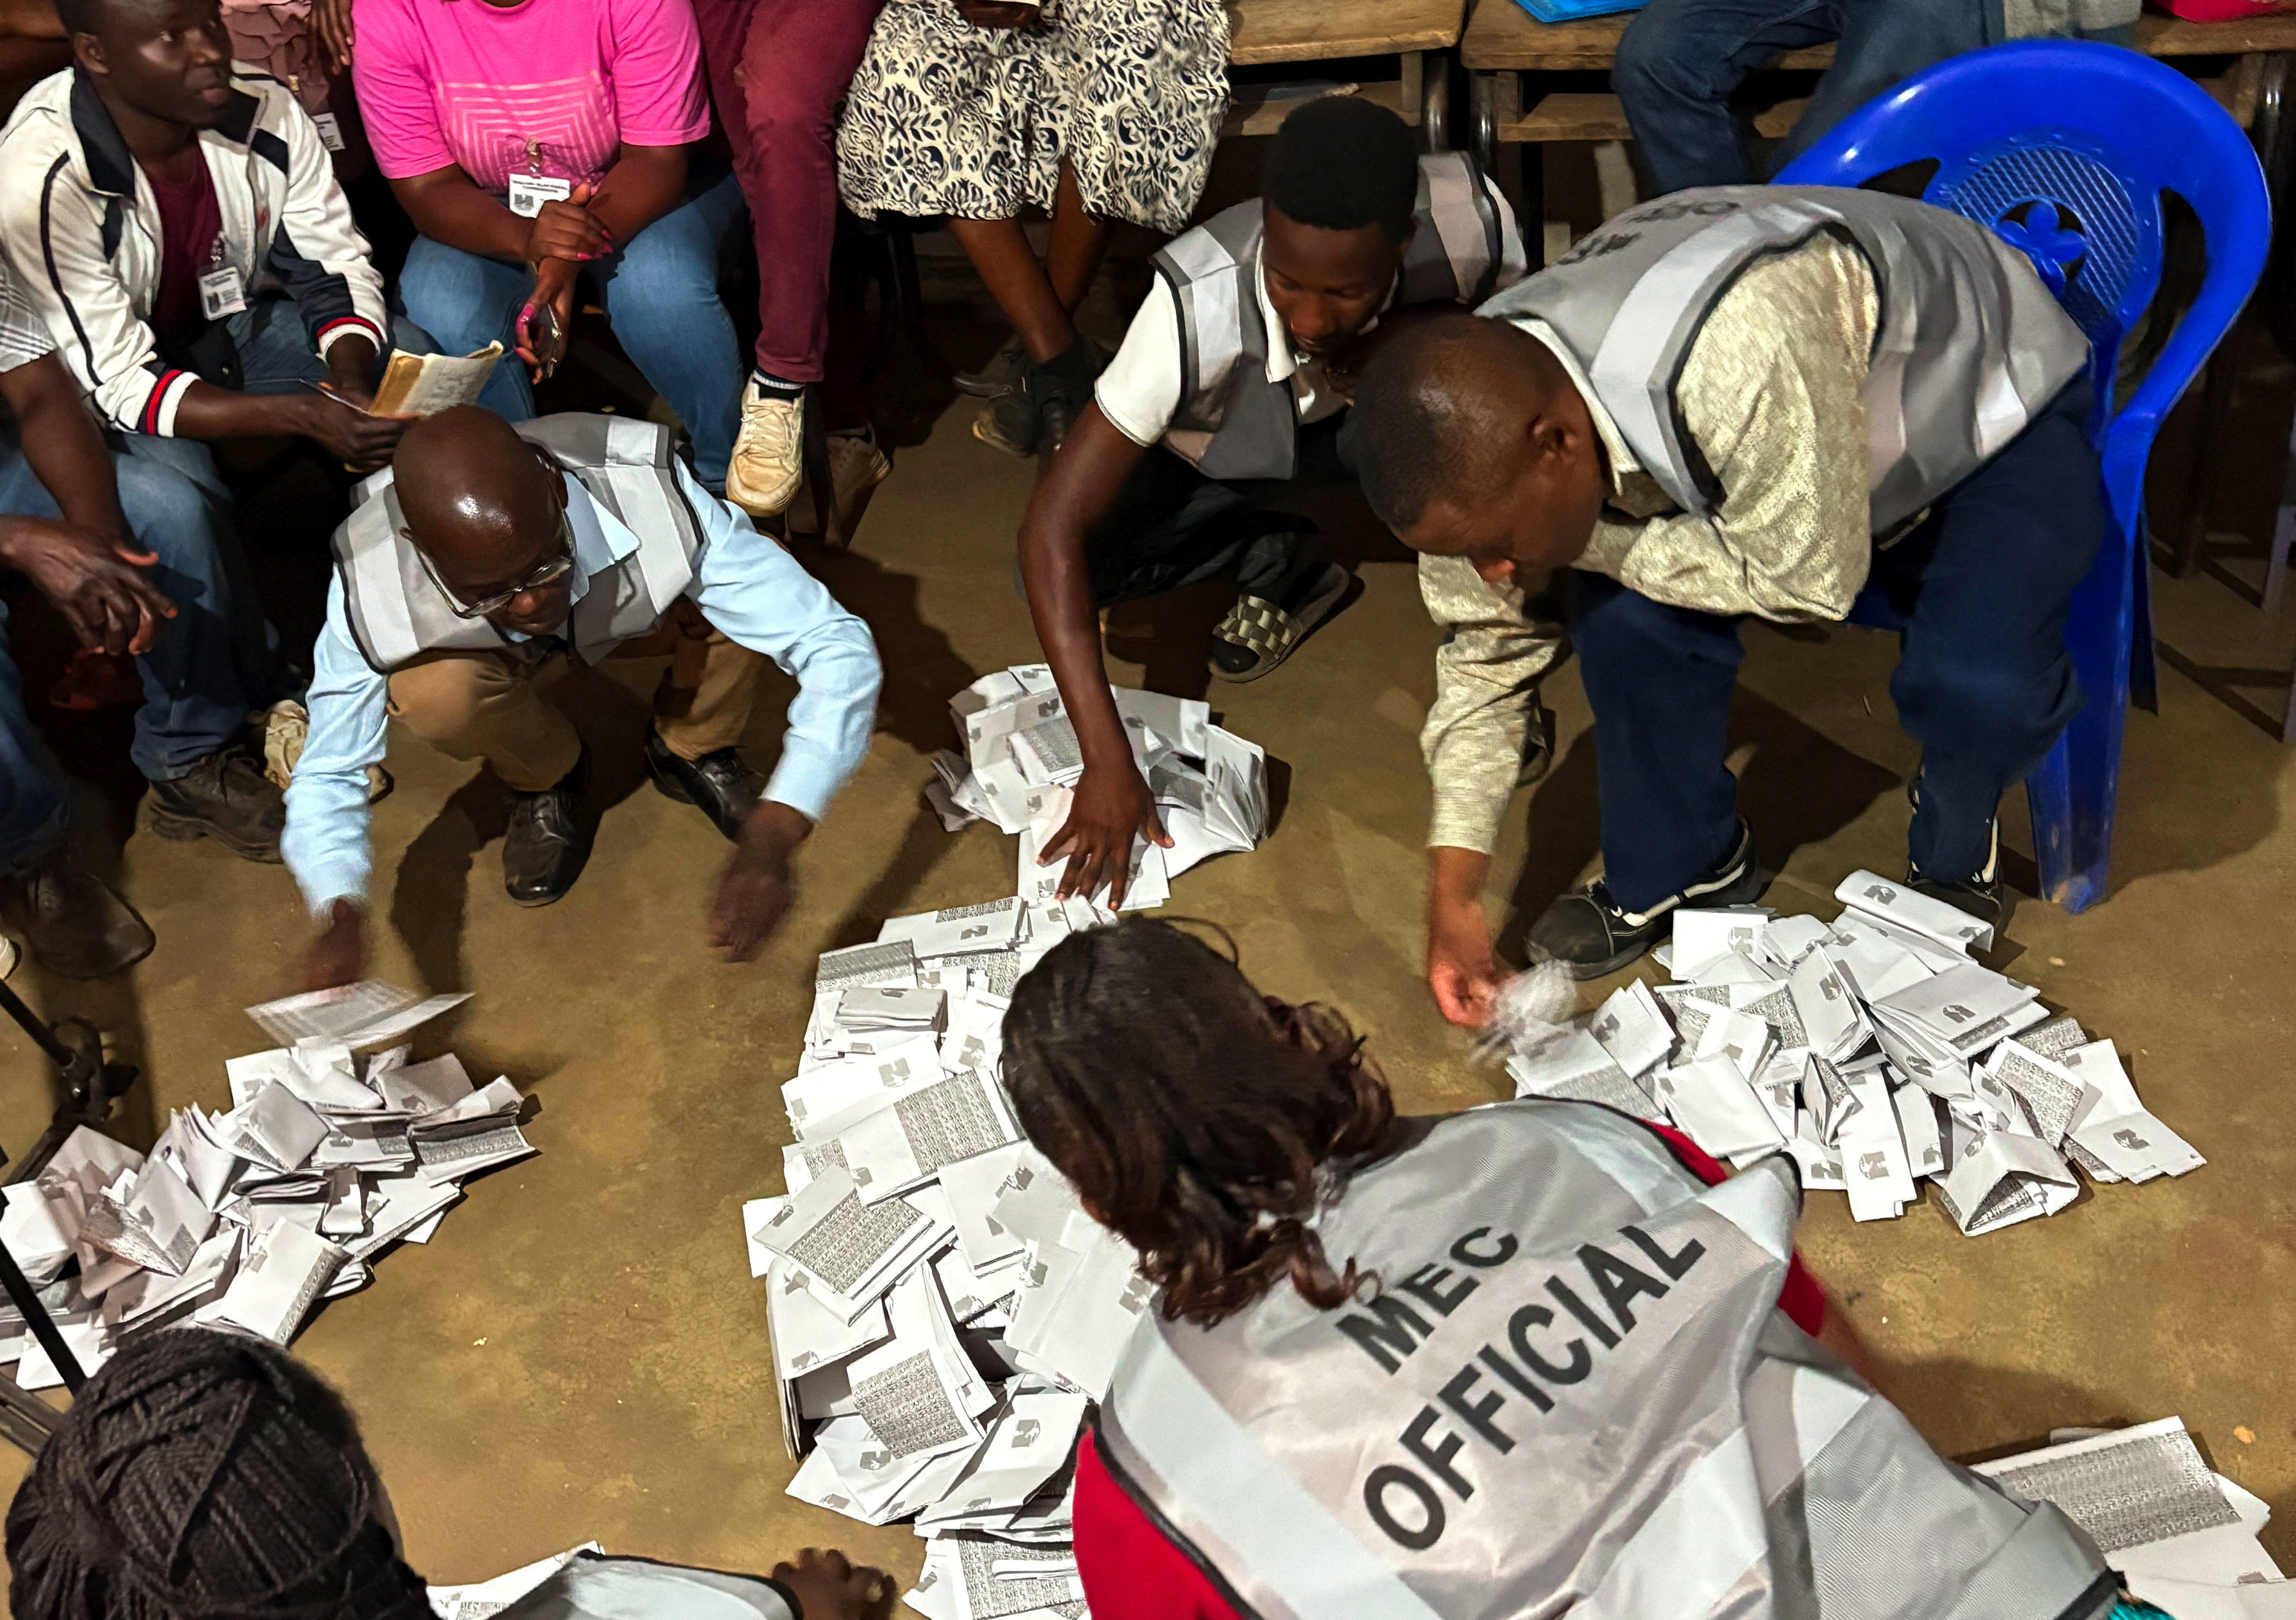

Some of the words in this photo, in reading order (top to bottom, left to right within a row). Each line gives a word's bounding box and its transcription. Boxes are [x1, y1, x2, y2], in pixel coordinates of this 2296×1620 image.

[1335, 1226, 1518, 1376] MEC
[1363, 1225, 1707, 1551] OFFICIAL
[1005, 1589, 1025, 1599] MEC
[1041, 1580, 1061, 1591] MEC
